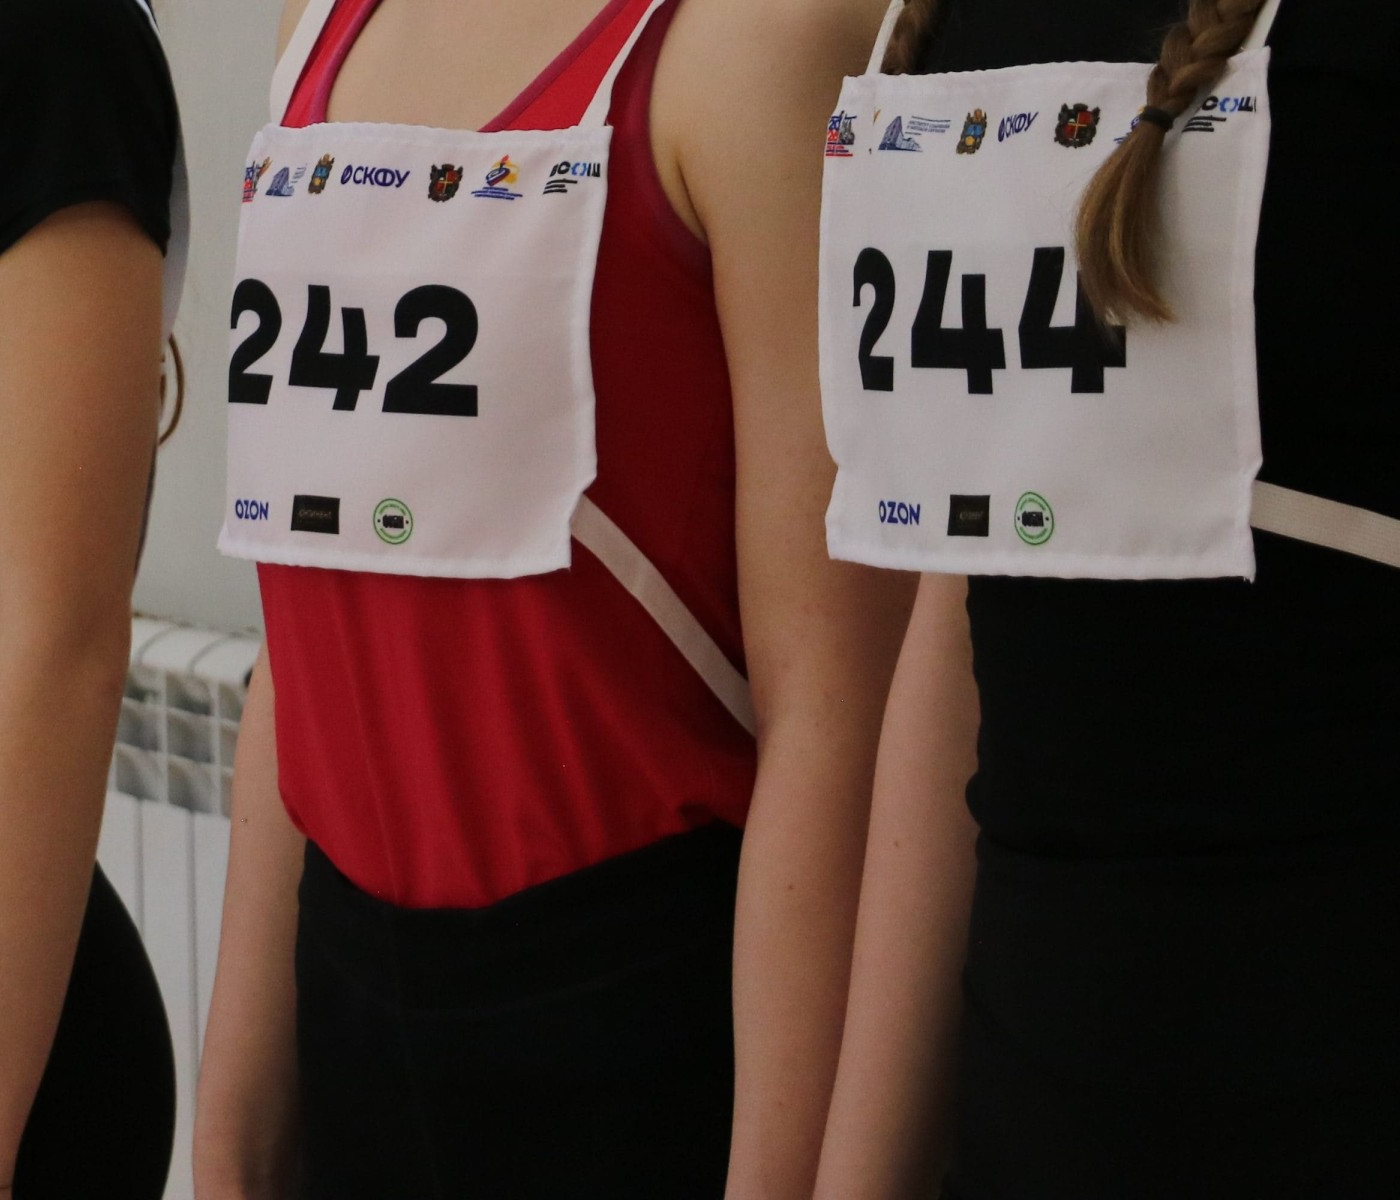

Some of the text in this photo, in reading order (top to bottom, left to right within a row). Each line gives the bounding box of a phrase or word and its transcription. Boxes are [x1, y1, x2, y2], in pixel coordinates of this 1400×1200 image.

[228, 278, 478, 417] 242
[853, 246, 1126, 394] 244
[235, 499, 269, 521] OZON
[879, 500, 921, 525] OZON
